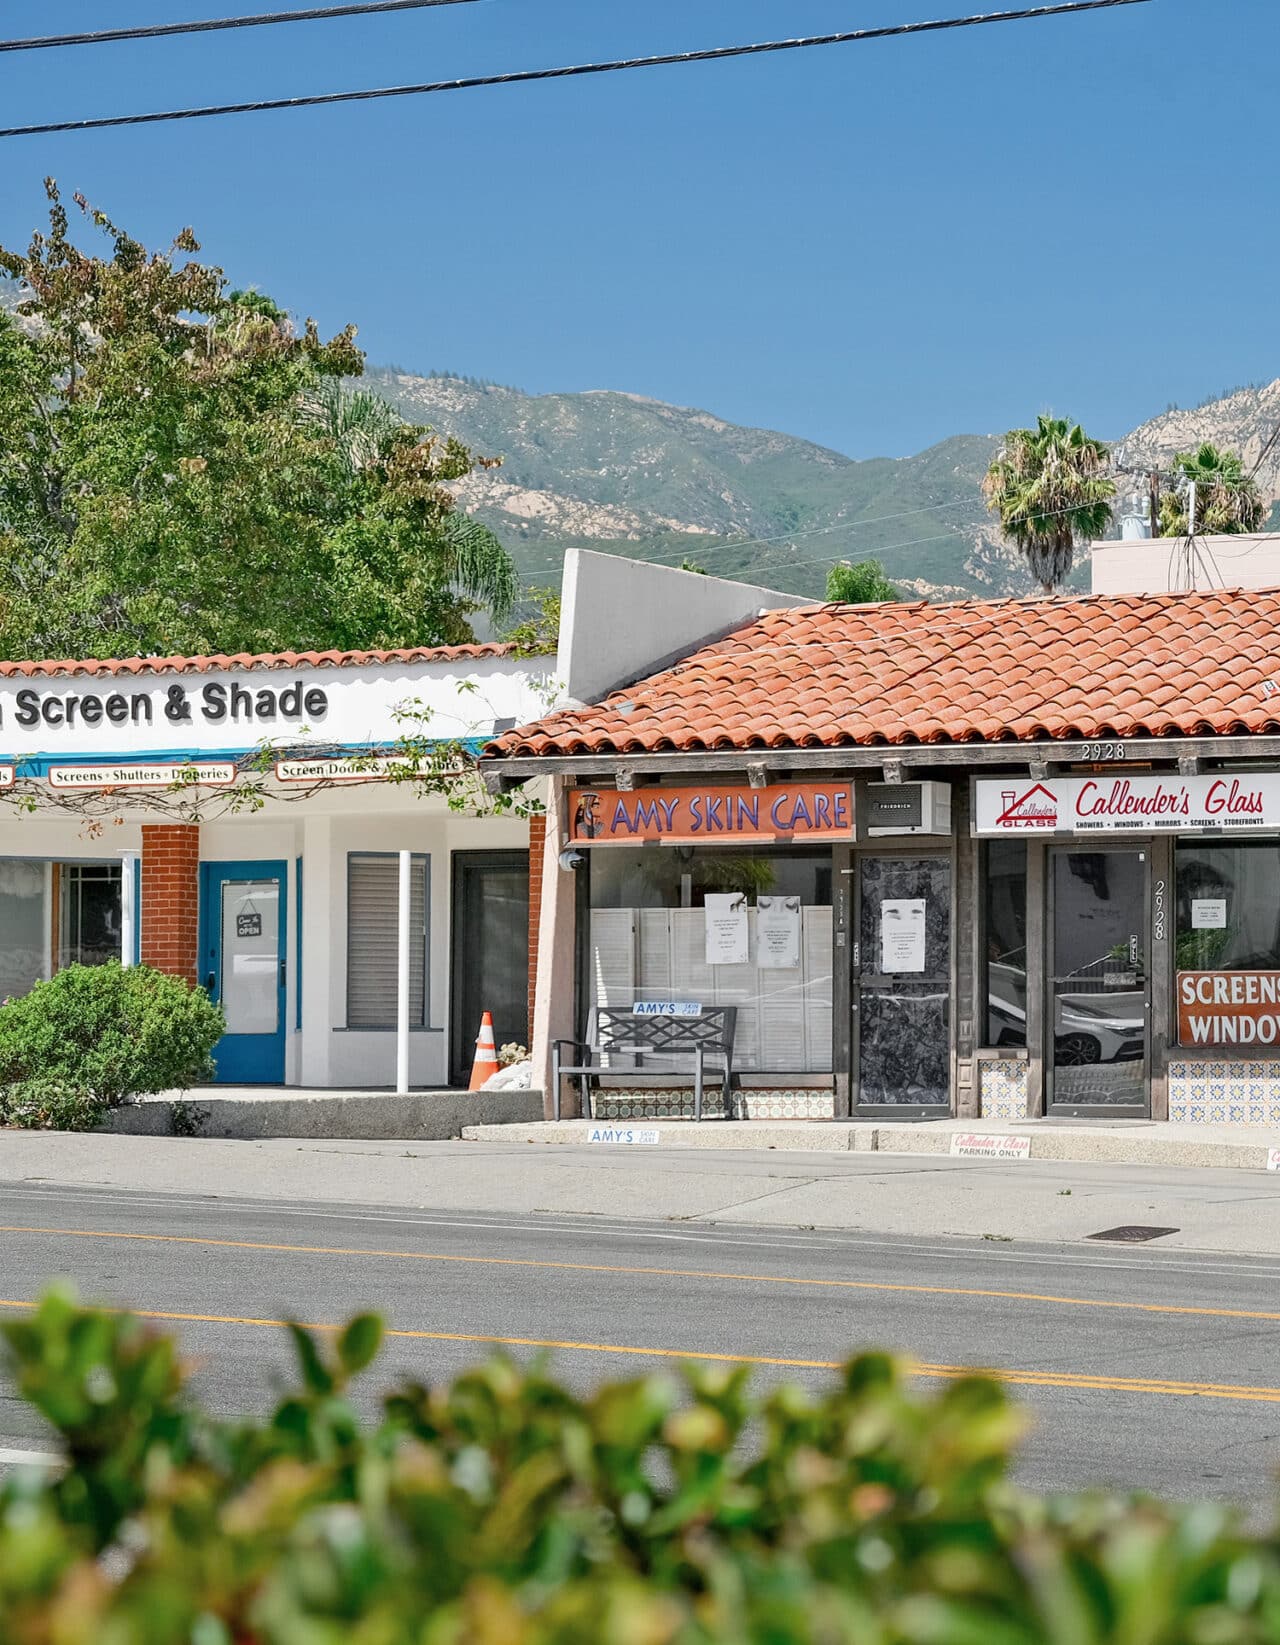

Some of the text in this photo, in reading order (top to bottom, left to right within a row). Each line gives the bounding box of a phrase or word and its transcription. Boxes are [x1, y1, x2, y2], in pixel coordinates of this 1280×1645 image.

[15, 689, 152, 725] Screen
[164, 684, 191, 720] &
[201, 681, 328, 718] Shade
[1081, 743, 1124, 759] 2928
[56, 770, 103, 782] Screens
[113, 768, 161, 780] Shutters
[282, 764, 324, 776] Screen
[371, 762, 380, 773] &
[1075, 779, 1264, 816] Callender's Glass
[610, 792, 848, 834] AMY SKIN CARE
[1003, 820, 1057, 828] GLASS
[1075, 821, 1104, 829] SHOWERS
[1114, 820, 1144, 828] WINDOWS
[1224, 818, 1265, 826] STOREFRONTS
[1155, 880, 1165, 940] 2928
[239, 927, 259, 935] OPEN
[636, 1003, 676, 1014] AMY'S
[591, 1129, 633, 1143] AMY'S
[959, 1147, 1022, 1158] PARKING ONLY
